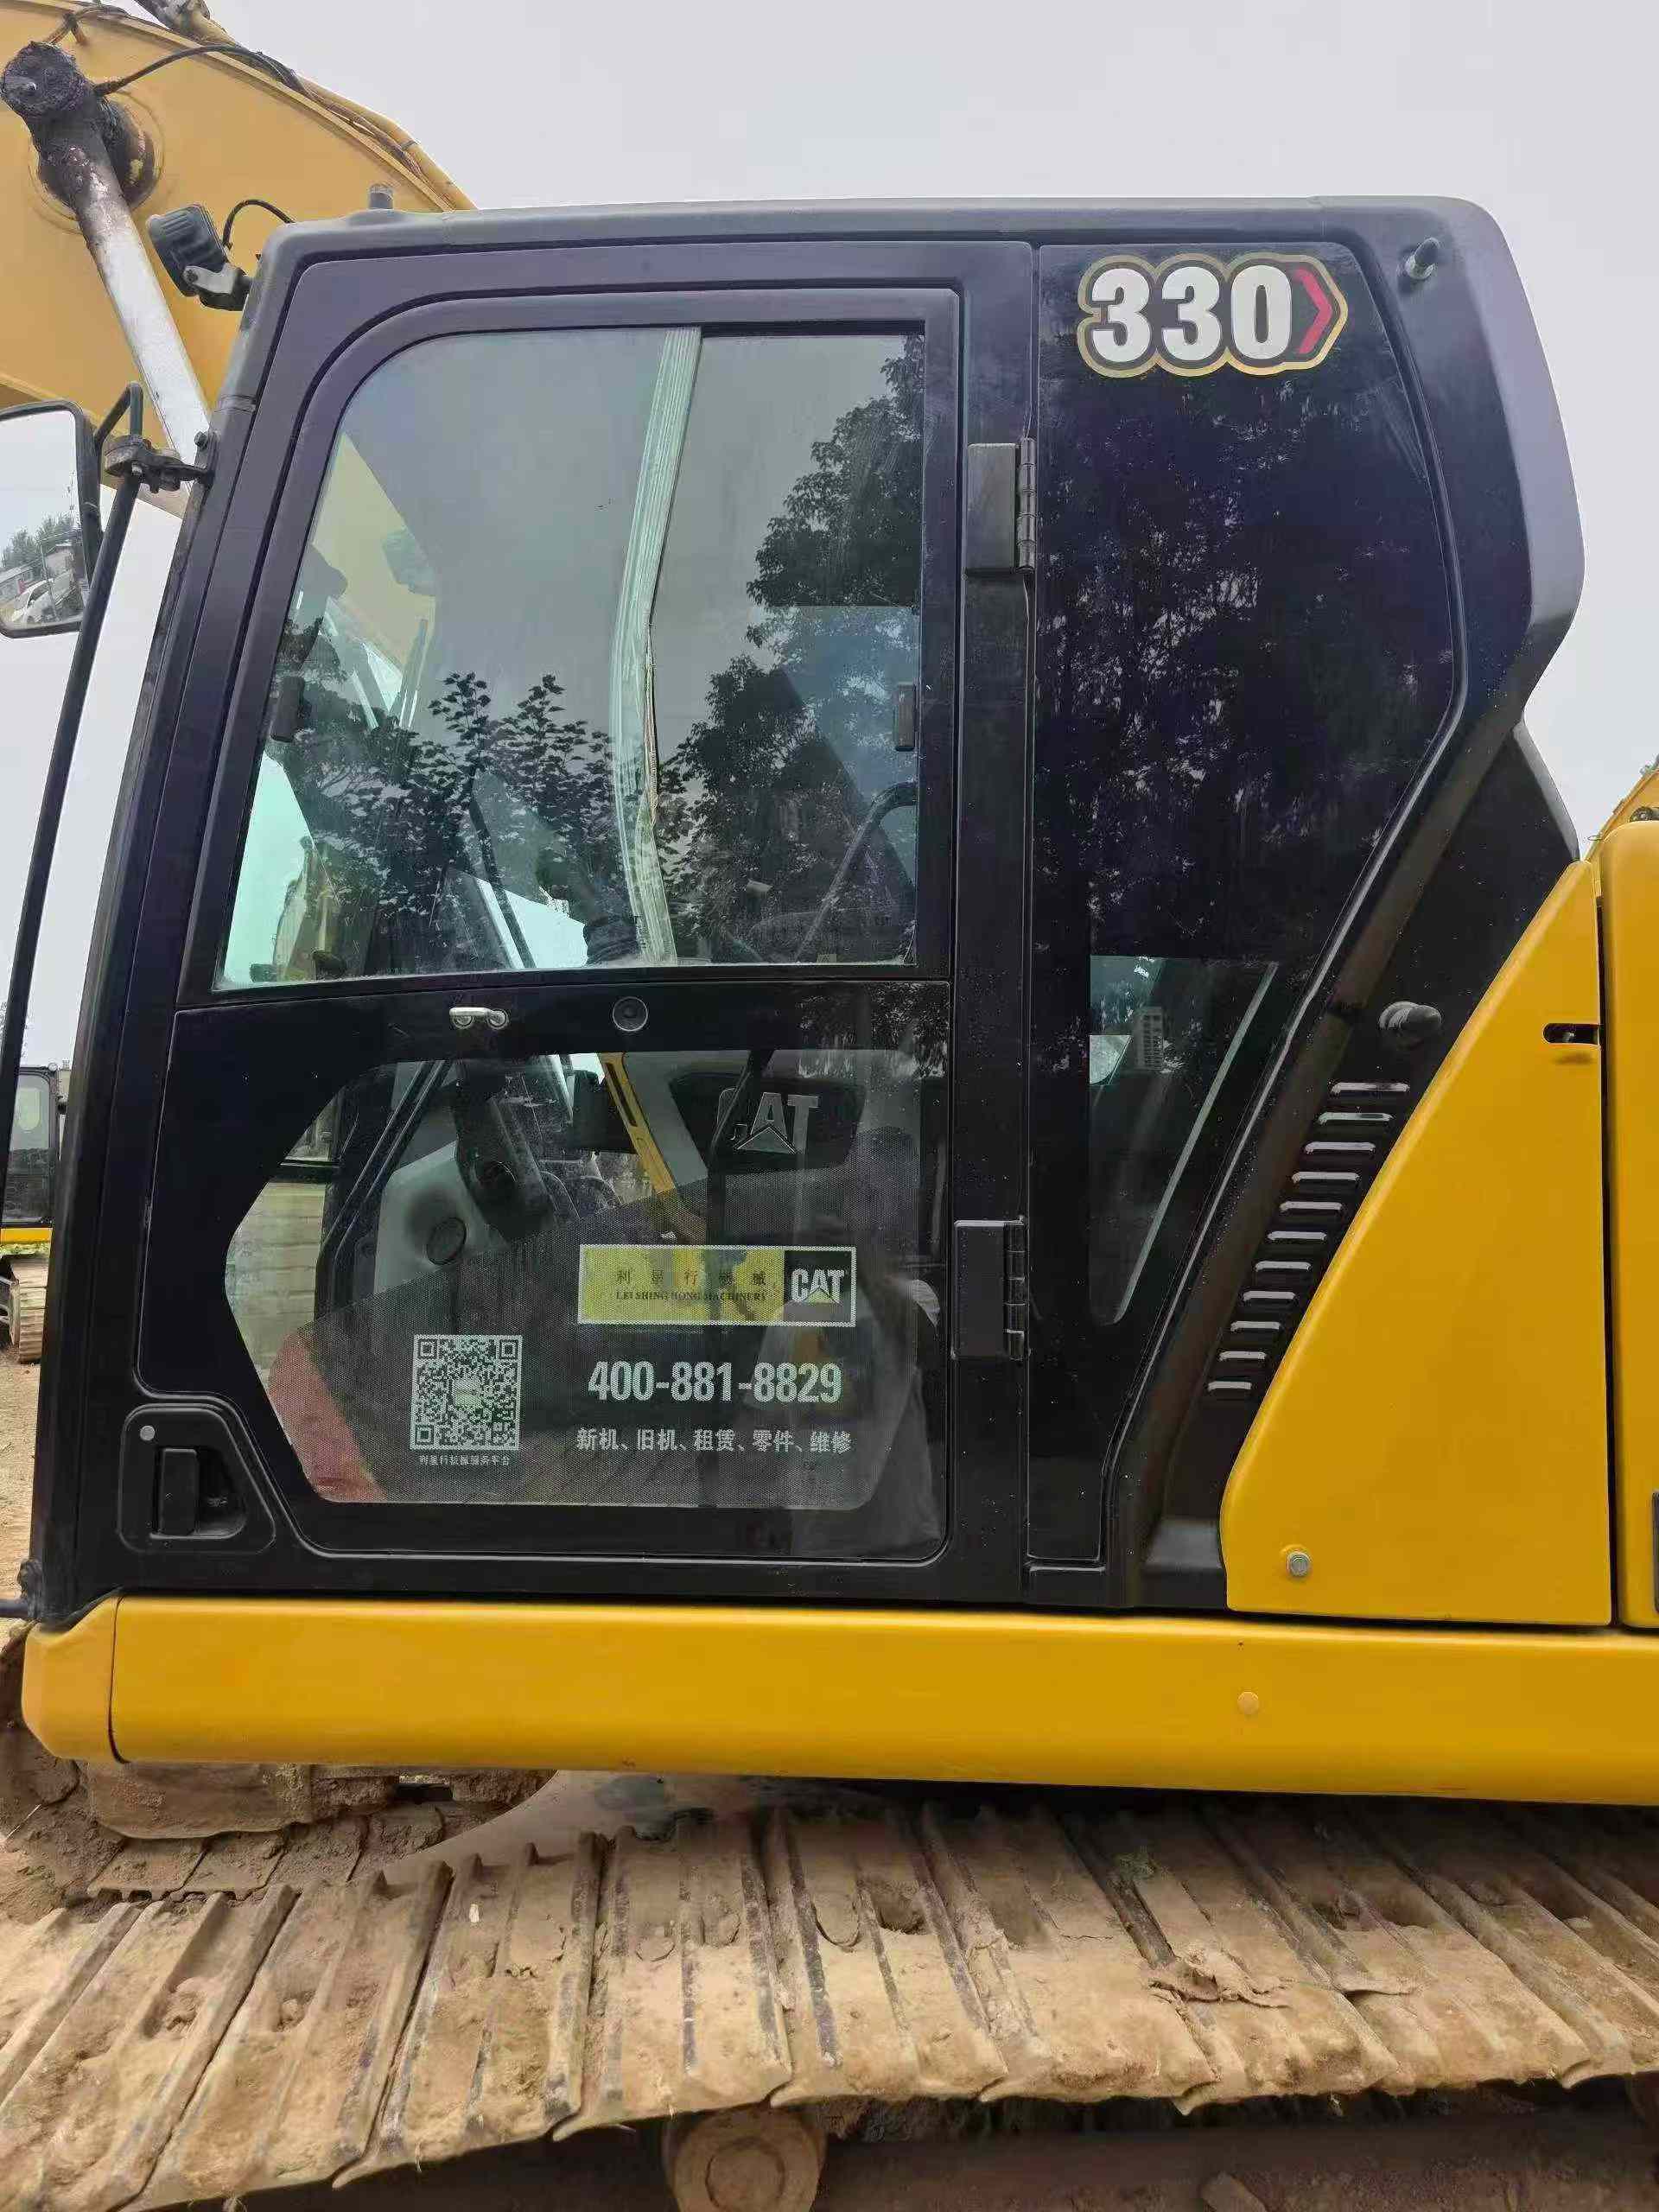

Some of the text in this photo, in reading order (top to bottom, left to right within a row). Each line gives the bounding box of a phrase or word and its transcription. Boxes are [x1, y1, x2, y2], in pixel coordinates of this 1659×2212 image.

[1091, 264, 1293, 363] 330
[791, 1268, 844, 1302] CAT
[588, 1360, 842, 1402] 400-881-8829
